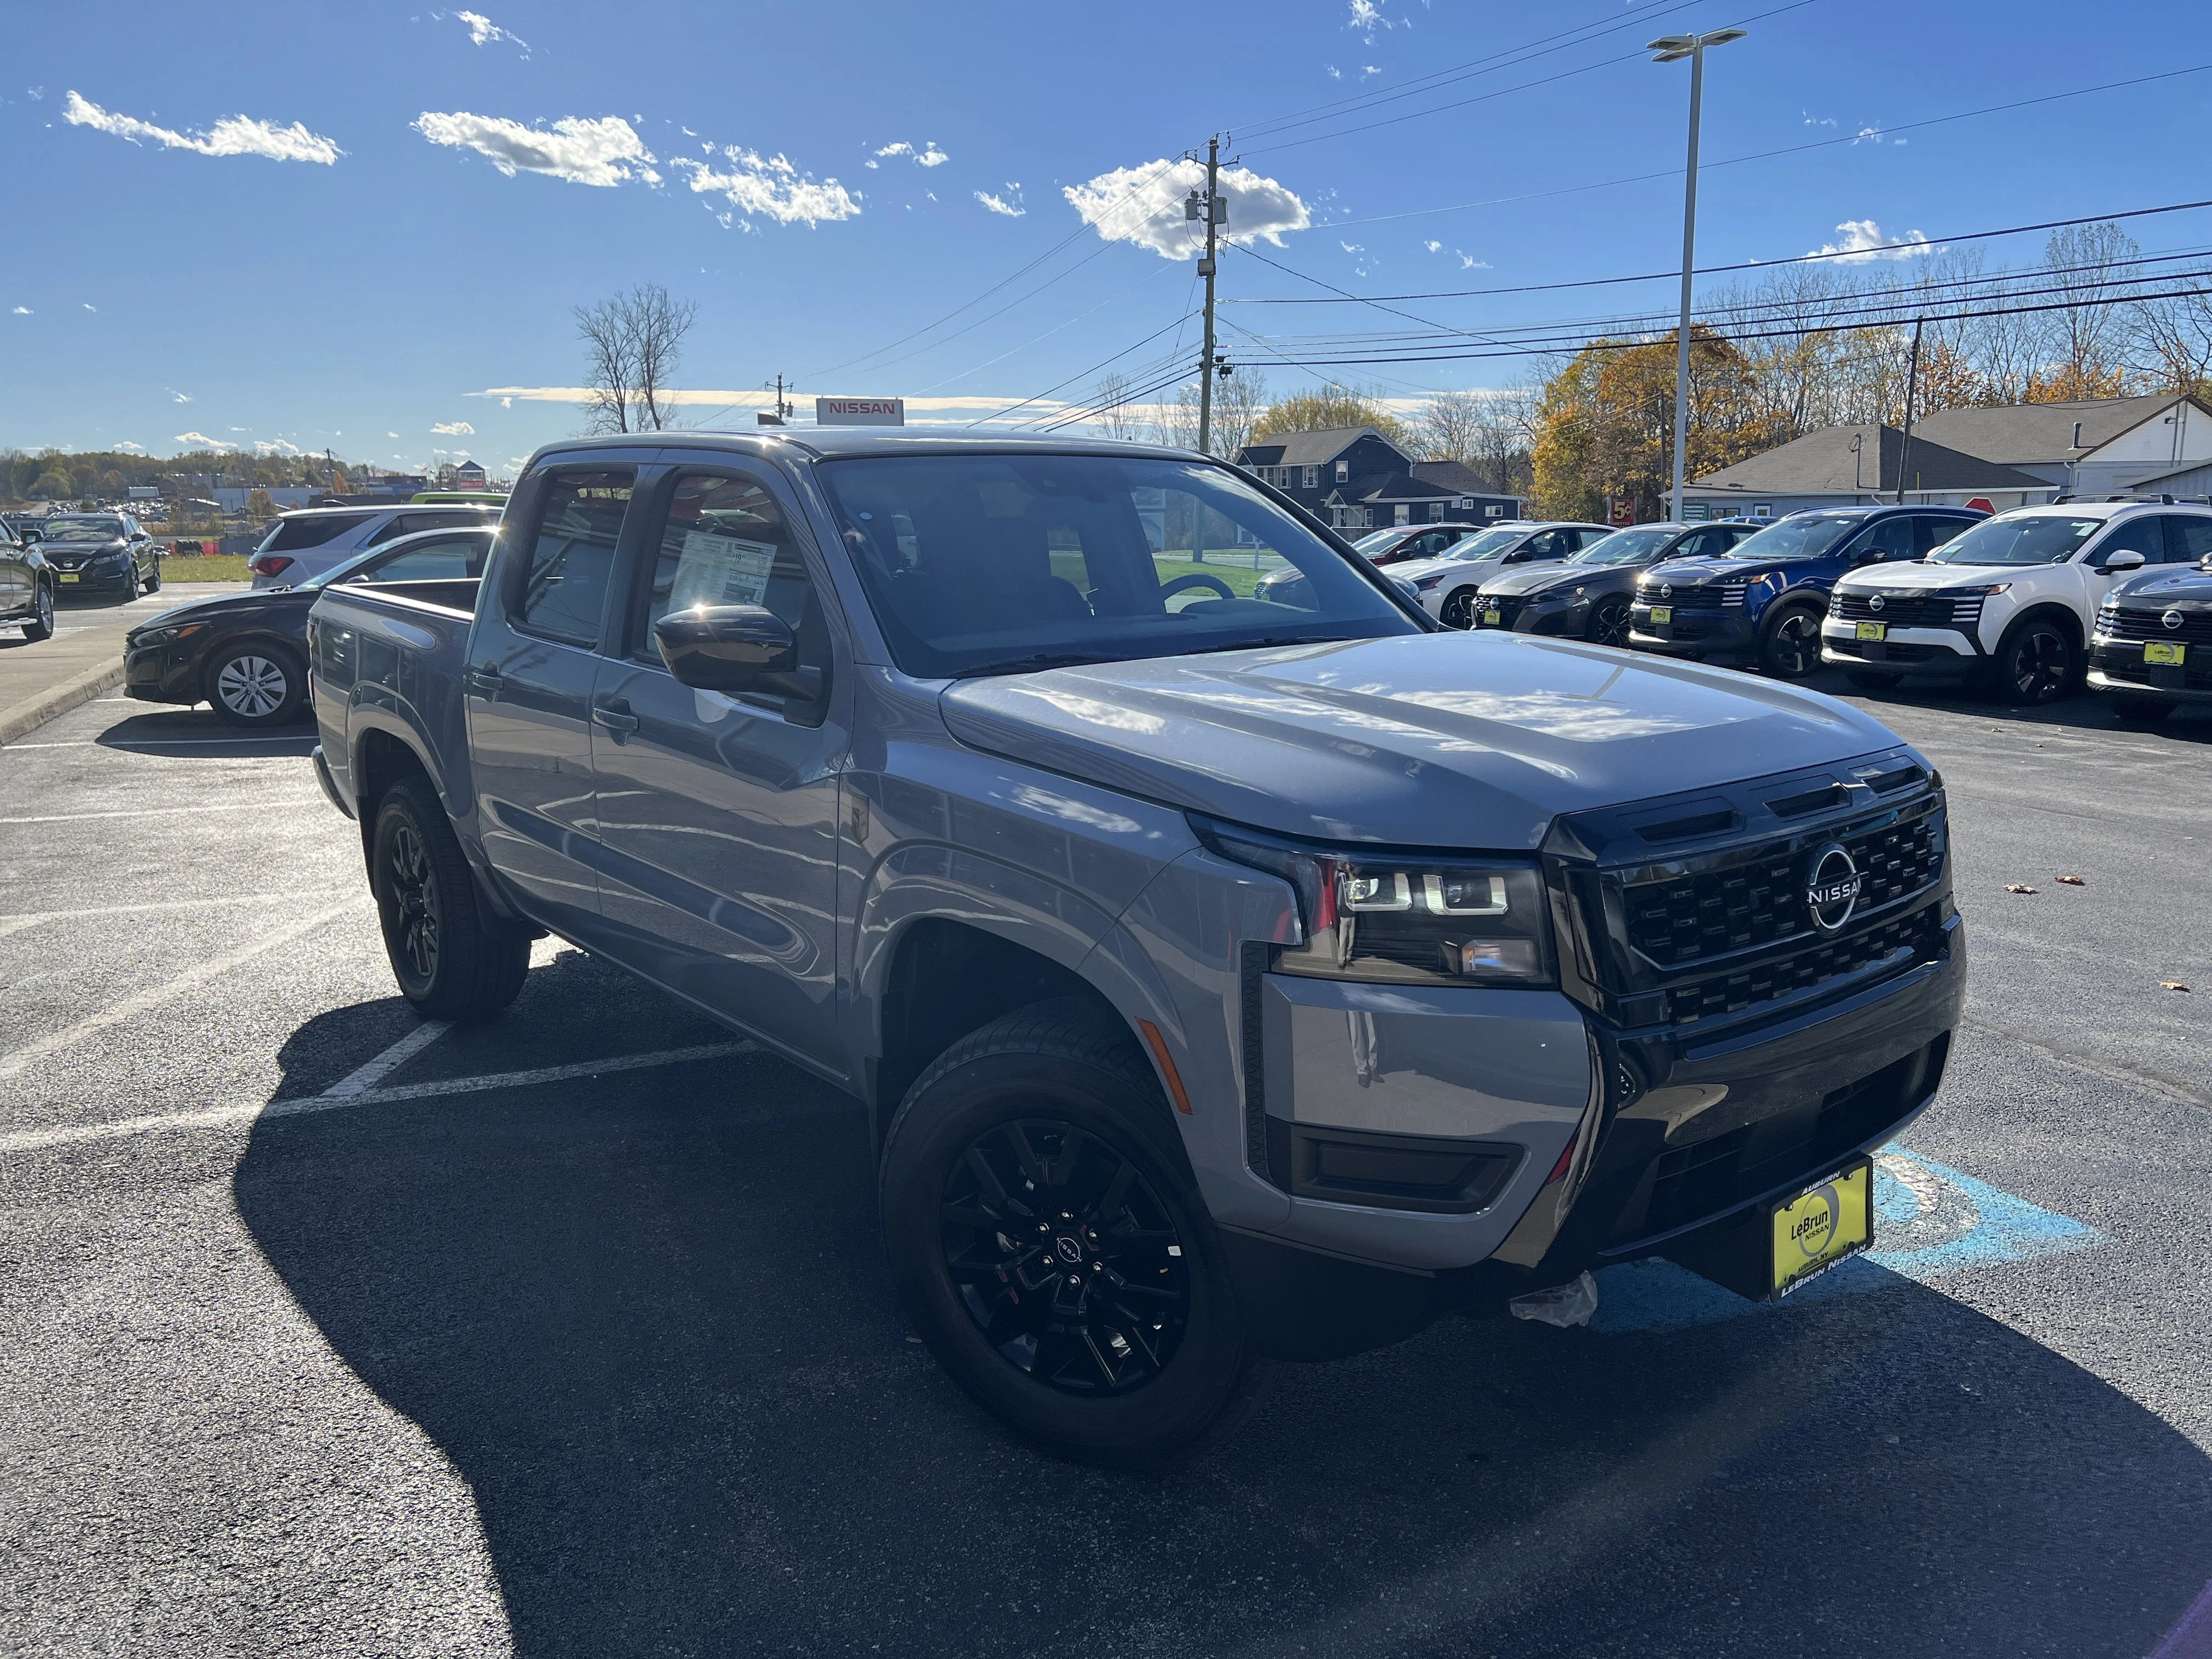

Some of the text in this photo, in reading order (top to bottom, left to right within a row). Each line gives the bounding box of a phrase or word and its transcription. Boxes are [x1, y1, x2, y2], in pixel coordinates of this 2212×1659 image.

[830, 403, 895, 414] NISSAN
[1613, 501, 1631, 520] 5¢
[1801, 1171, 1841, 1196] AUBURN
[1791, 1210, 1828, 1241] LeBrun
[1805, 1223, 1829, 1241] NISSAN
[1056, 1237, 1082, 1262] NISSAN
[1827, 1244, 1866, 1271] NISSAN
